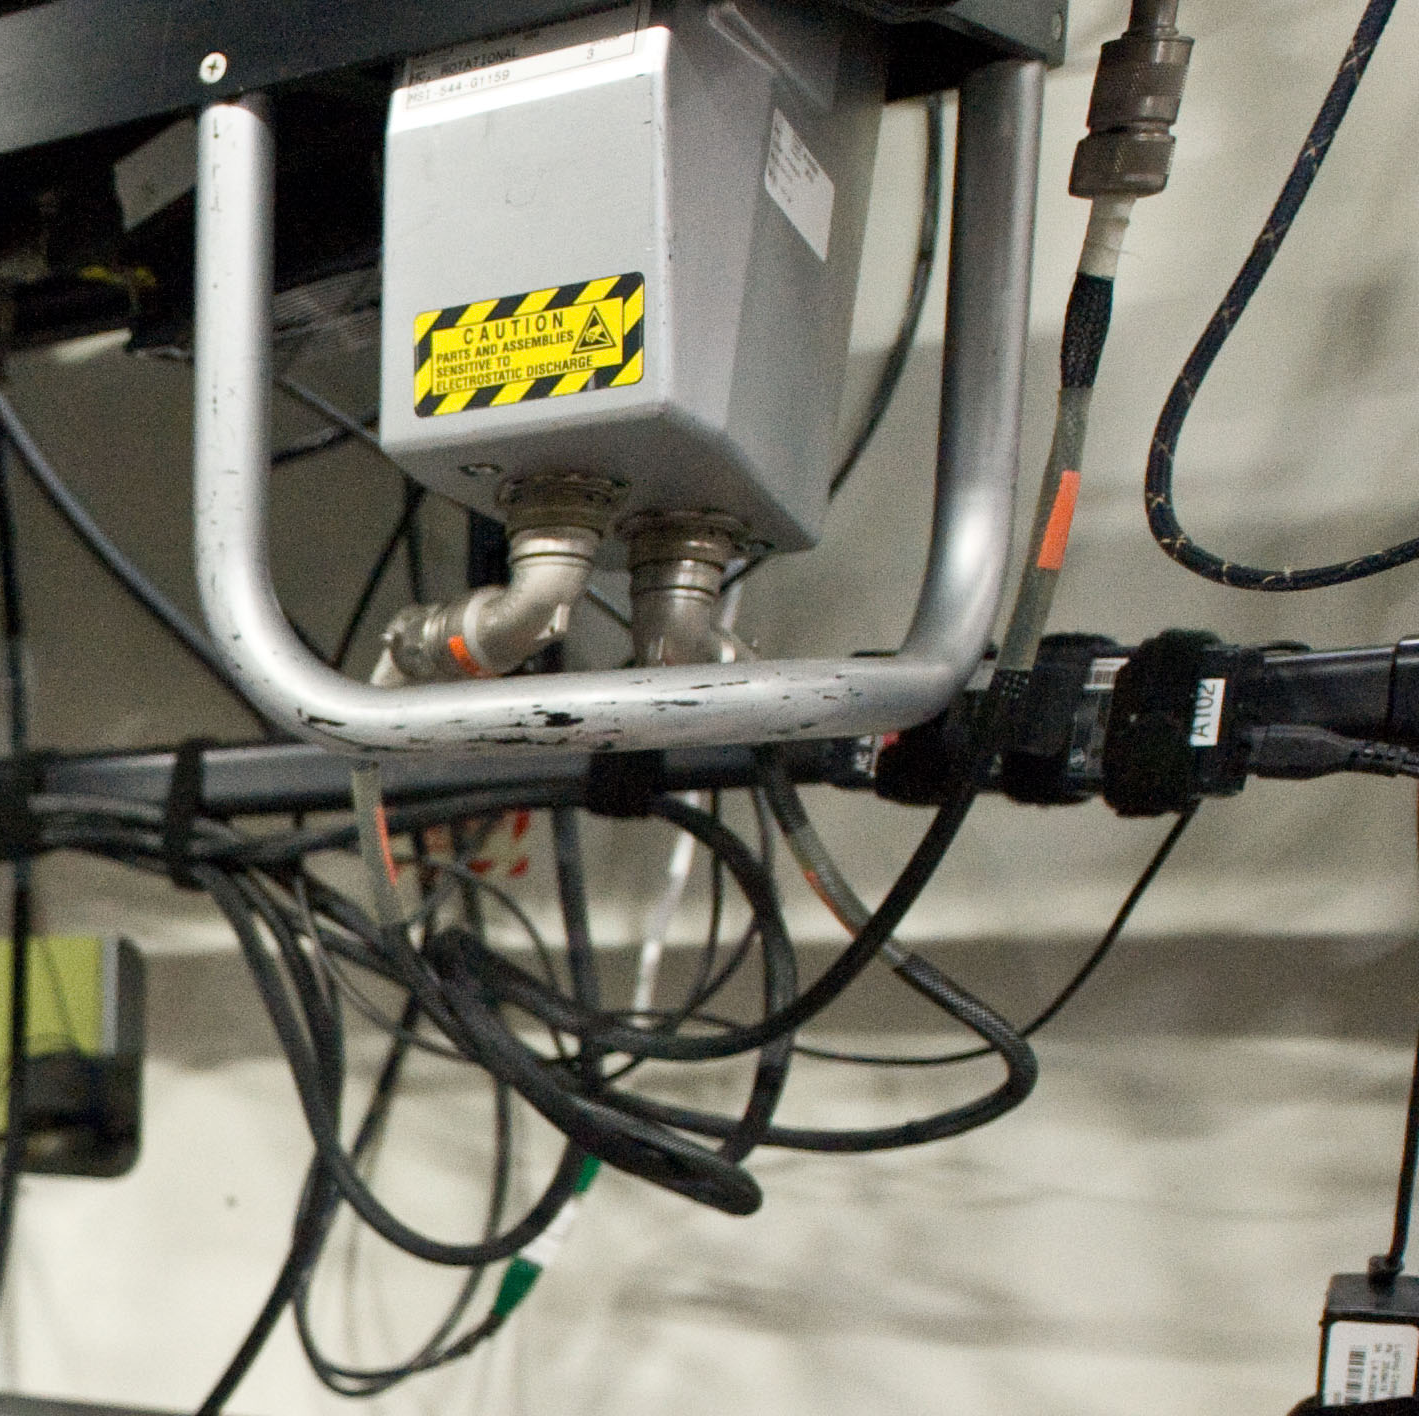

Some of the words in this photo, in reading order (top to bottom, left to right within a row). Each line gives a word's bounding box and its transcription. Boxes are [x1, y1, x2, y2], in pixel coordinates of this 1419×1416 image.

[463, 311, 564, 346] CAUTION
[435, 350, 471, 364] PARTS
[475, 343, 498, 358] AND
[502, 330, 574, 354] ASSEMBLIES
[435, 369, 522, 393] ELECTROSTATIC
[526, 355, 593, 377] DISCHARGE
[436, 360, 491, 379] SENSITIVE
[496, 356, 511, 369] TO
